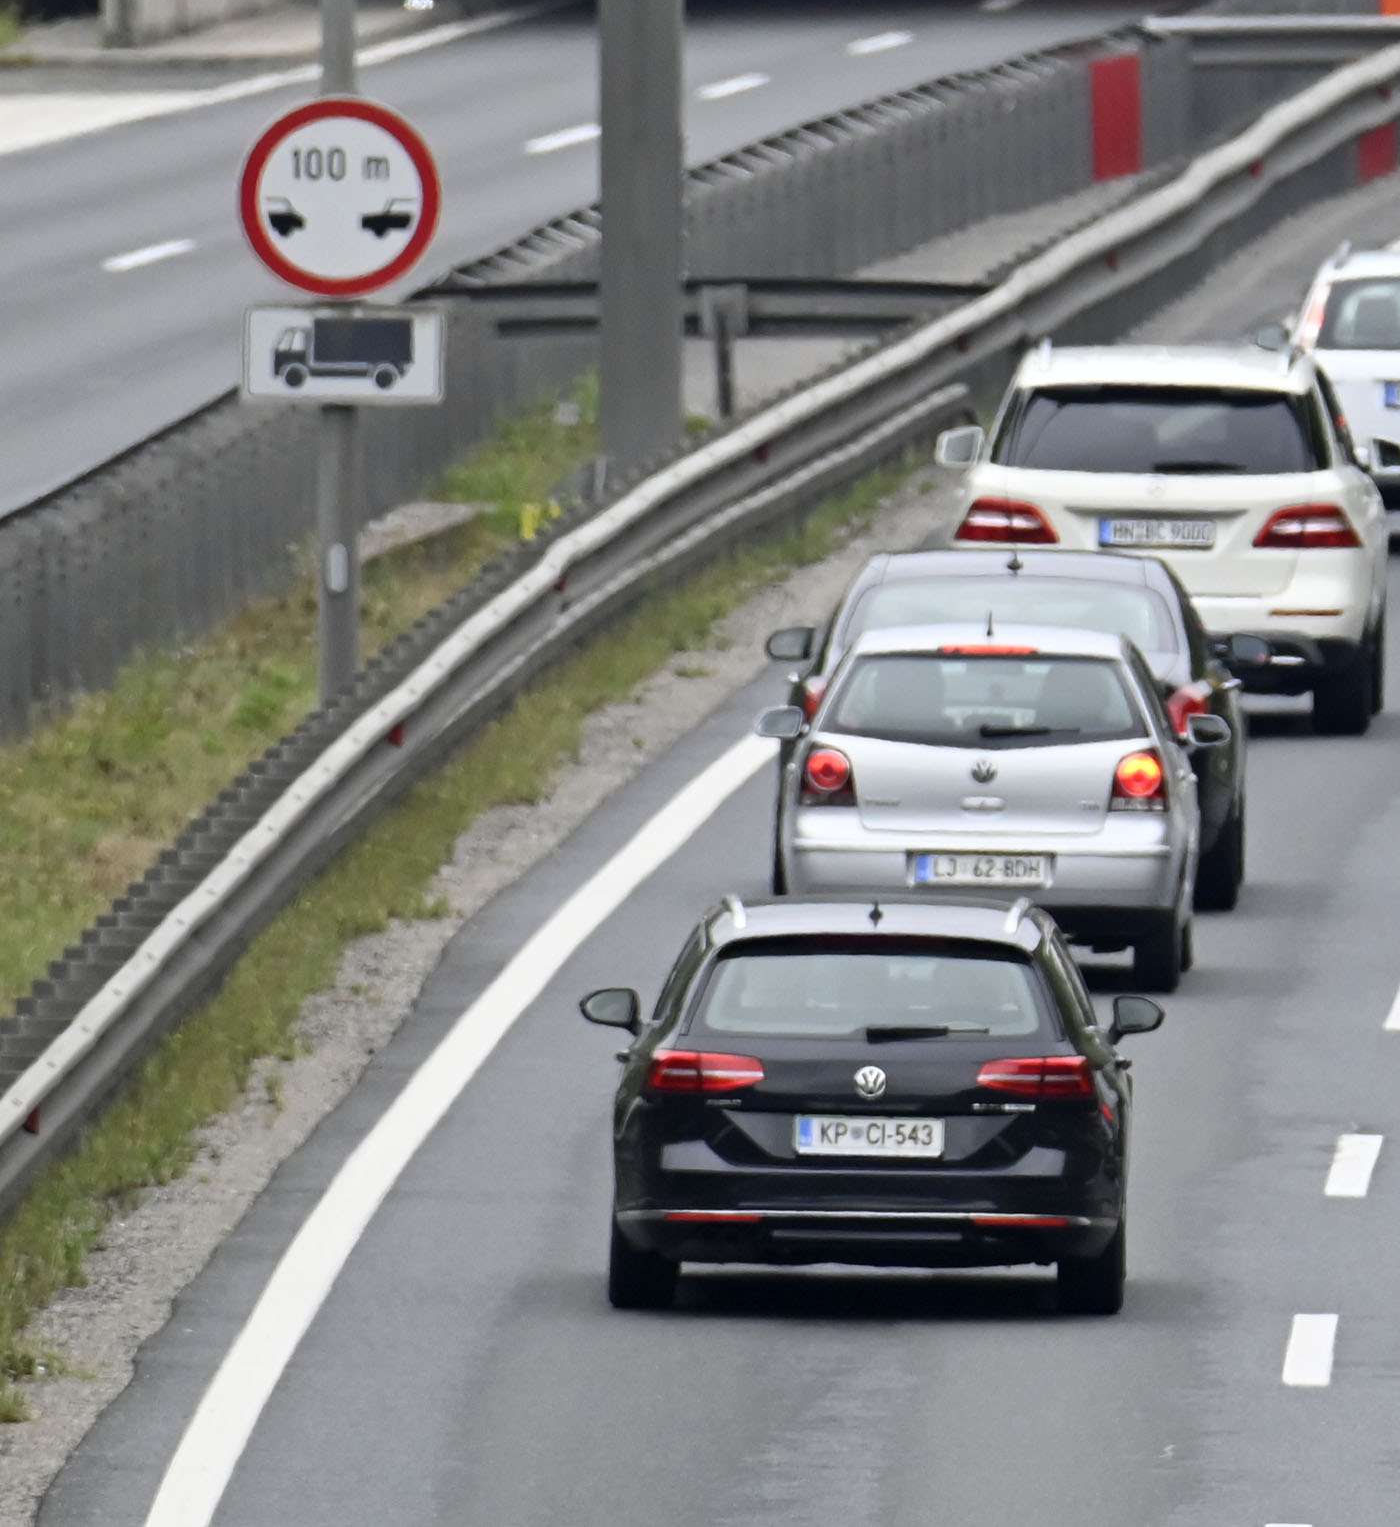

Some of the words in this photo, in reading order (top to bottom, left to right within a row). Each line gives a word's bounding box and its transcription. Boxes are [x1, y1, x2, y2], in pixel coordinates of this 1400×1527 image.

[291, 146, 347, 181] 100
[364, 155, 391, 180] m
[820, 1122, 849, 1145] KP
[865, 1122, 934, 1148] CI-543
